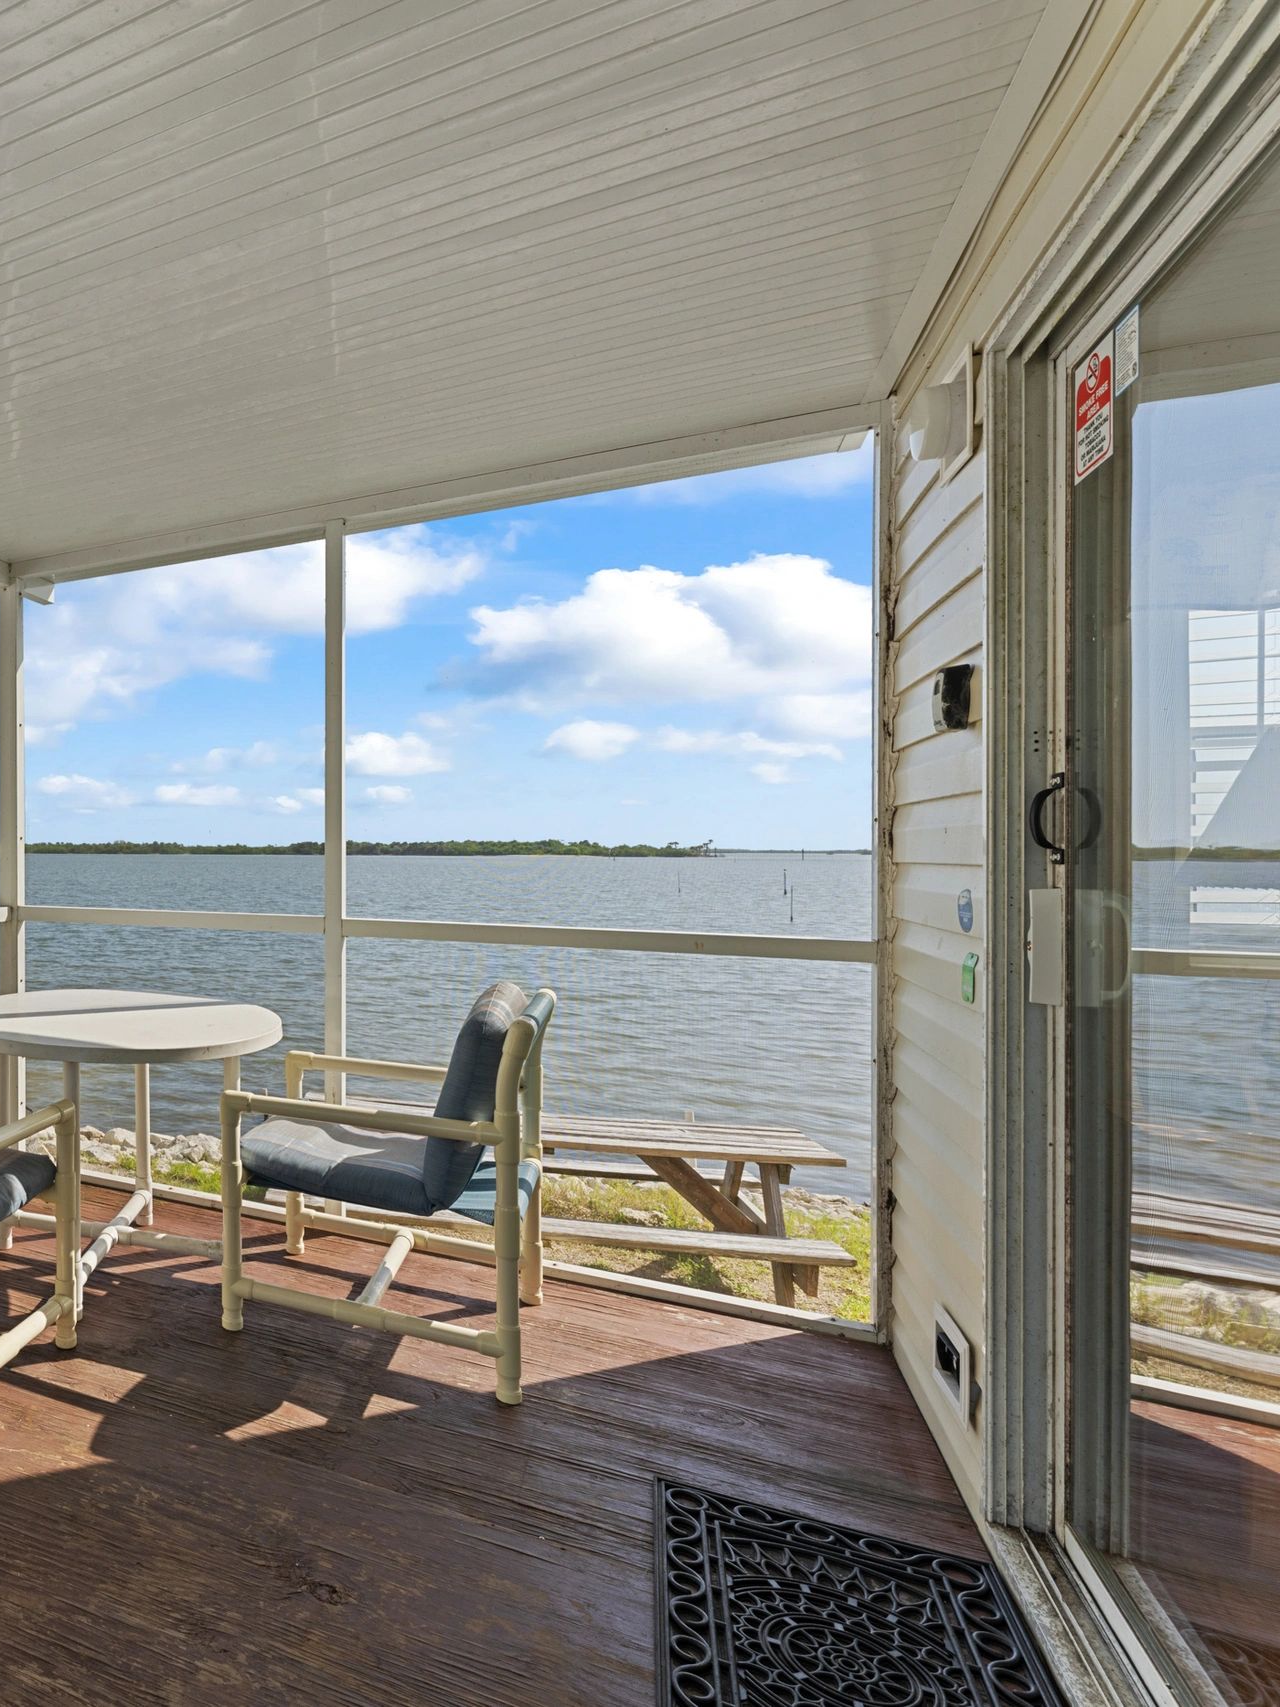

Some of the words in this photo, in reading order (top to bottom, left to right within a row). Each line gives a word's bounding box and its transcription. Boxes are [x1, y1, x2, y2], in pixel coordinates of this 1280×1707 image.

[1078, 393, 1095, 416] SMOKE
[1096, 380, 1109, 399] FREE
[1087, 401, 1100, 420] AREA
[1084, 419, 1095, 431] THANK
[1093, 414, 1109, 432] SMOKING
[1085, 430, 1101, 446] TOBACCO
[1086, 435, 1106, 456] MARIJUANA
[1095, 444, 1104, 456] TIME
